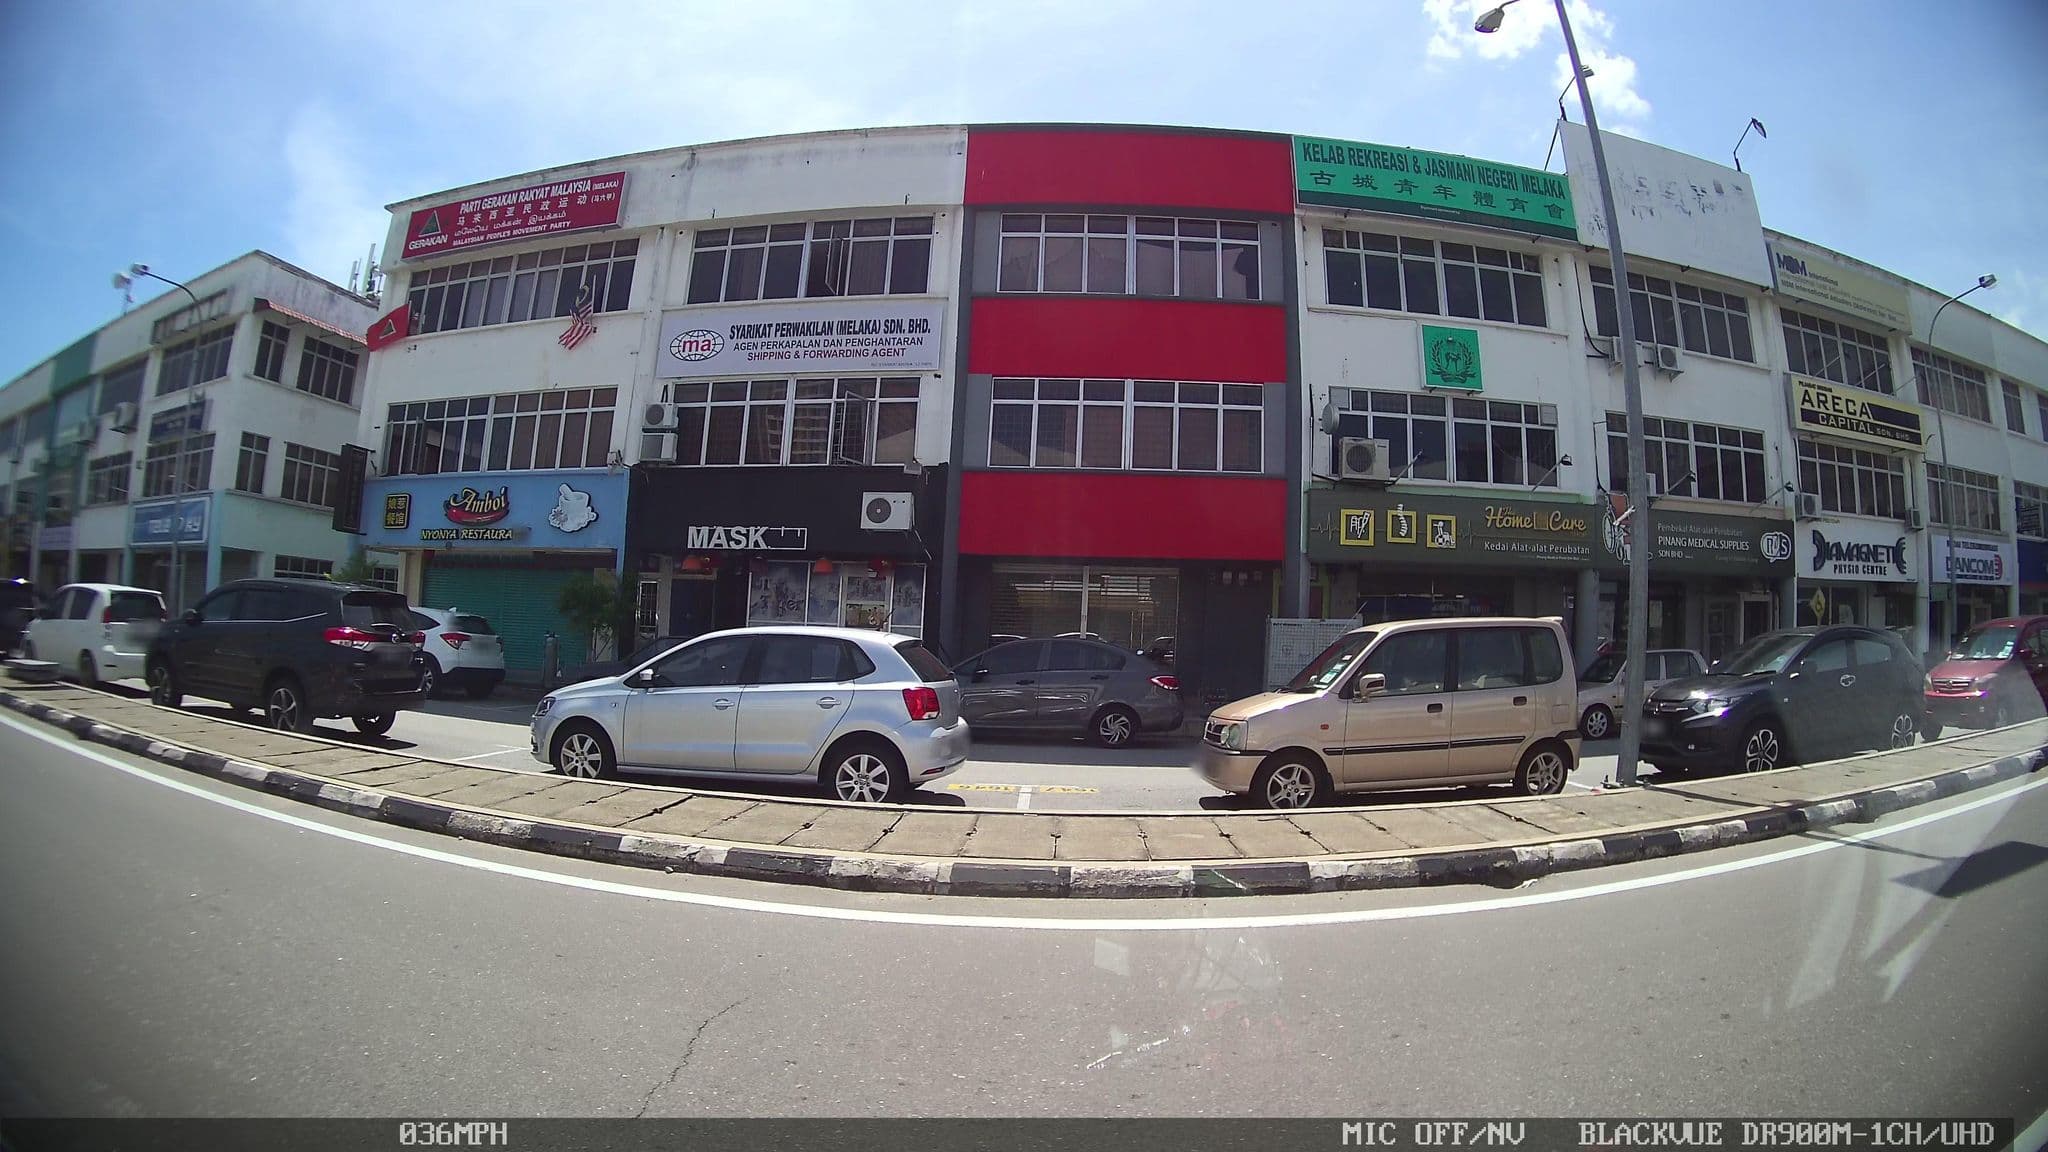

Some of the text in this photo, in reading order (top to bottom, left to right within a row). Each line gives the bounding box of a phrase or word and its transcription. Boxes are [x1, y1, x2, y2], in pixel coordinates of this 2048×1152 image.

[1302, 142, 1565, 200] KELAB REKREASI & JASMANI NEGERI MELAKA
[460, 200, 481, 214] PARTI
[482, 193, 518, 210] GERAKAN
[518, 186, 551, 202] RAKYAT
[551, 180, 591, 197] MALAYSIA
[1309, 170, 1565, 219] 古城青年體育會
[408, 234, 448, 250] GERAKAN
[452, 235, 485, 246] MALAYSIAN
[512, 224, 547, 236] MOVEMENT
[549, 220, 571, 230] PARTY
[729, 318, 931, 340] SYARIKAT PERWAKILAN (MELAKA) SDN. BHD.
[681, 336, 712, 353] ma
[733, 336, 924, 352] AGEN PERKAPALAN DAN PENGHANTARAN
[747, 347, 906, 361] SHIPPING & FORWARDING AGENT
[1801, 389, 1871, 420] ARECA
[1819, 413, 1874, 434] CAPITAL
[450, 486, 508, 514] Amboi
[1485, 505, 1587, 531] Home Care
[421, 528, 520, 541] NYONYA RESTAURA
[687, 526, 769, 549] MASK
[1658, 535, 1750, 551] PINANG MEDICAL SUPPLIES
[1484, 541, 1590, 554] Kedai Alat-alat Perubatan
[1833, 563, 1888, 576] PHYSIO CENTRE
